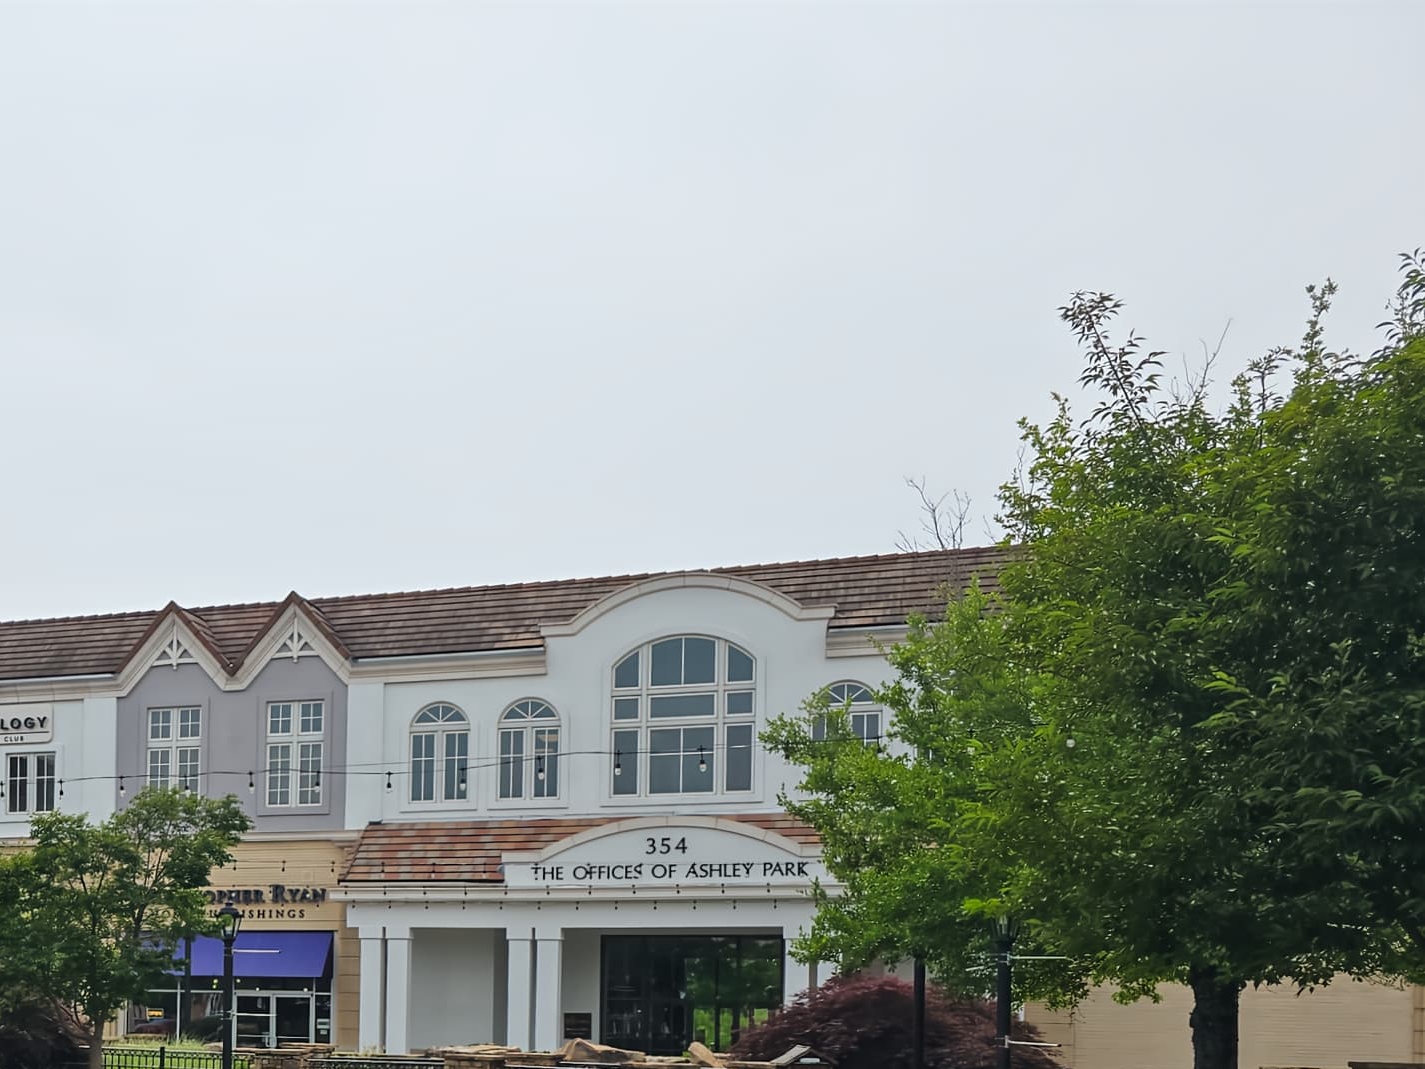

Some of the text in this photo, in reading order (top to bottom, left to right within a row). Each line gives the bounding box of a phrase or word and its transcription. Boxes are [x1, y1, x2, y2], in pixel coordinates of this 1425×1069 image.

[4, 735, 25, 743] CLUB
[645, 836, 688, 854] 354
[531, 861, 809, 881] THE OFFICES OF ASHLEY PARK
